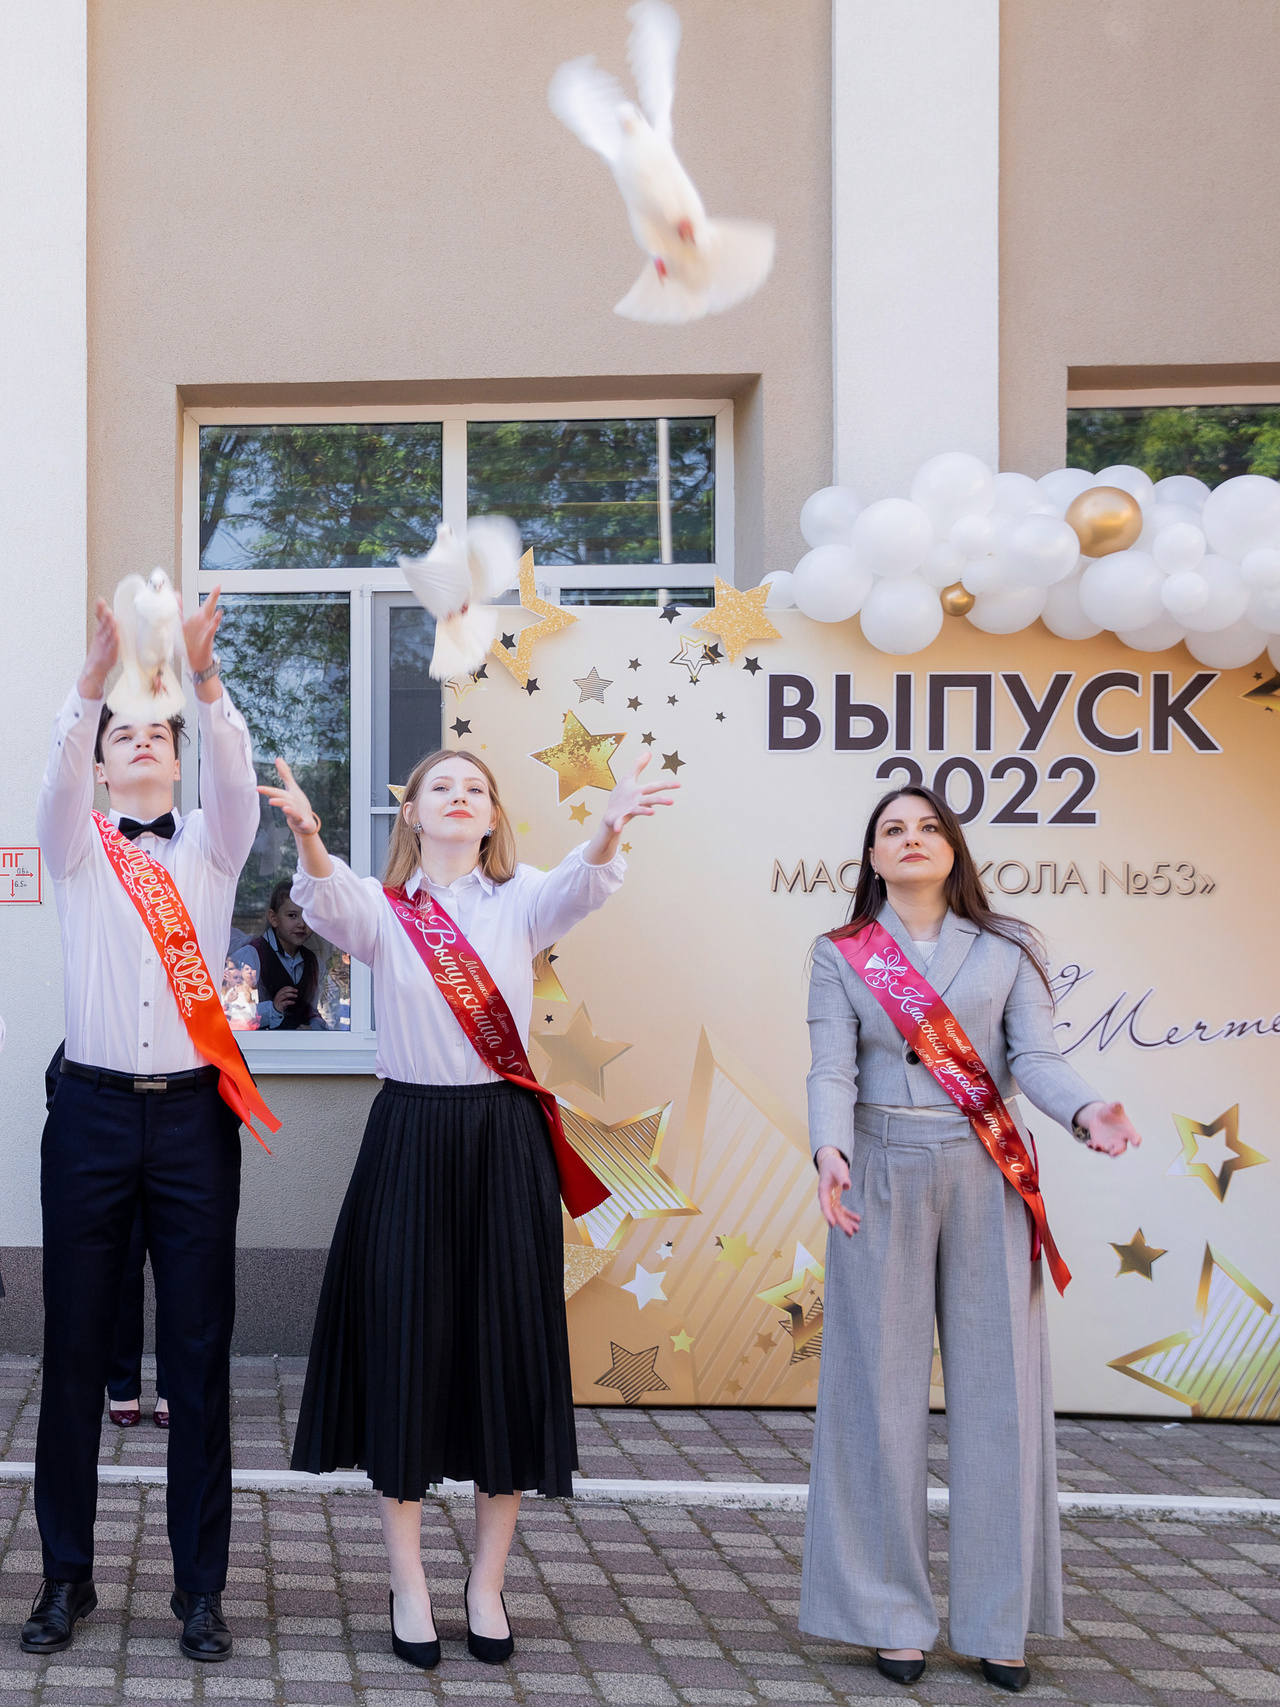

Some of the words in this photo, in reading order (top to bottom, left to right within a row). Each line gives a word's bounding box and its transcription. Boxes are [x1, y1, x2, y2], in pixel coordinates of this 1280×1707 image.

[767, 671, 1221, 753] ВЫПУСК
[876, 756, 1097, 825] 2022
[2, 852, 24, 868] ПГ
[975, 860, 1088, 895] КОЛА
[167, 940, 213, 1007] 2022
[414, 915, 502, 1048] Выпускница
[495, 1052, 525, 1076] 20
[887, 979, 951, 1056] Классный
[935, 1057, 1005, 1149] руководитель
[1003, 1153, 1034, 1193] 2022
